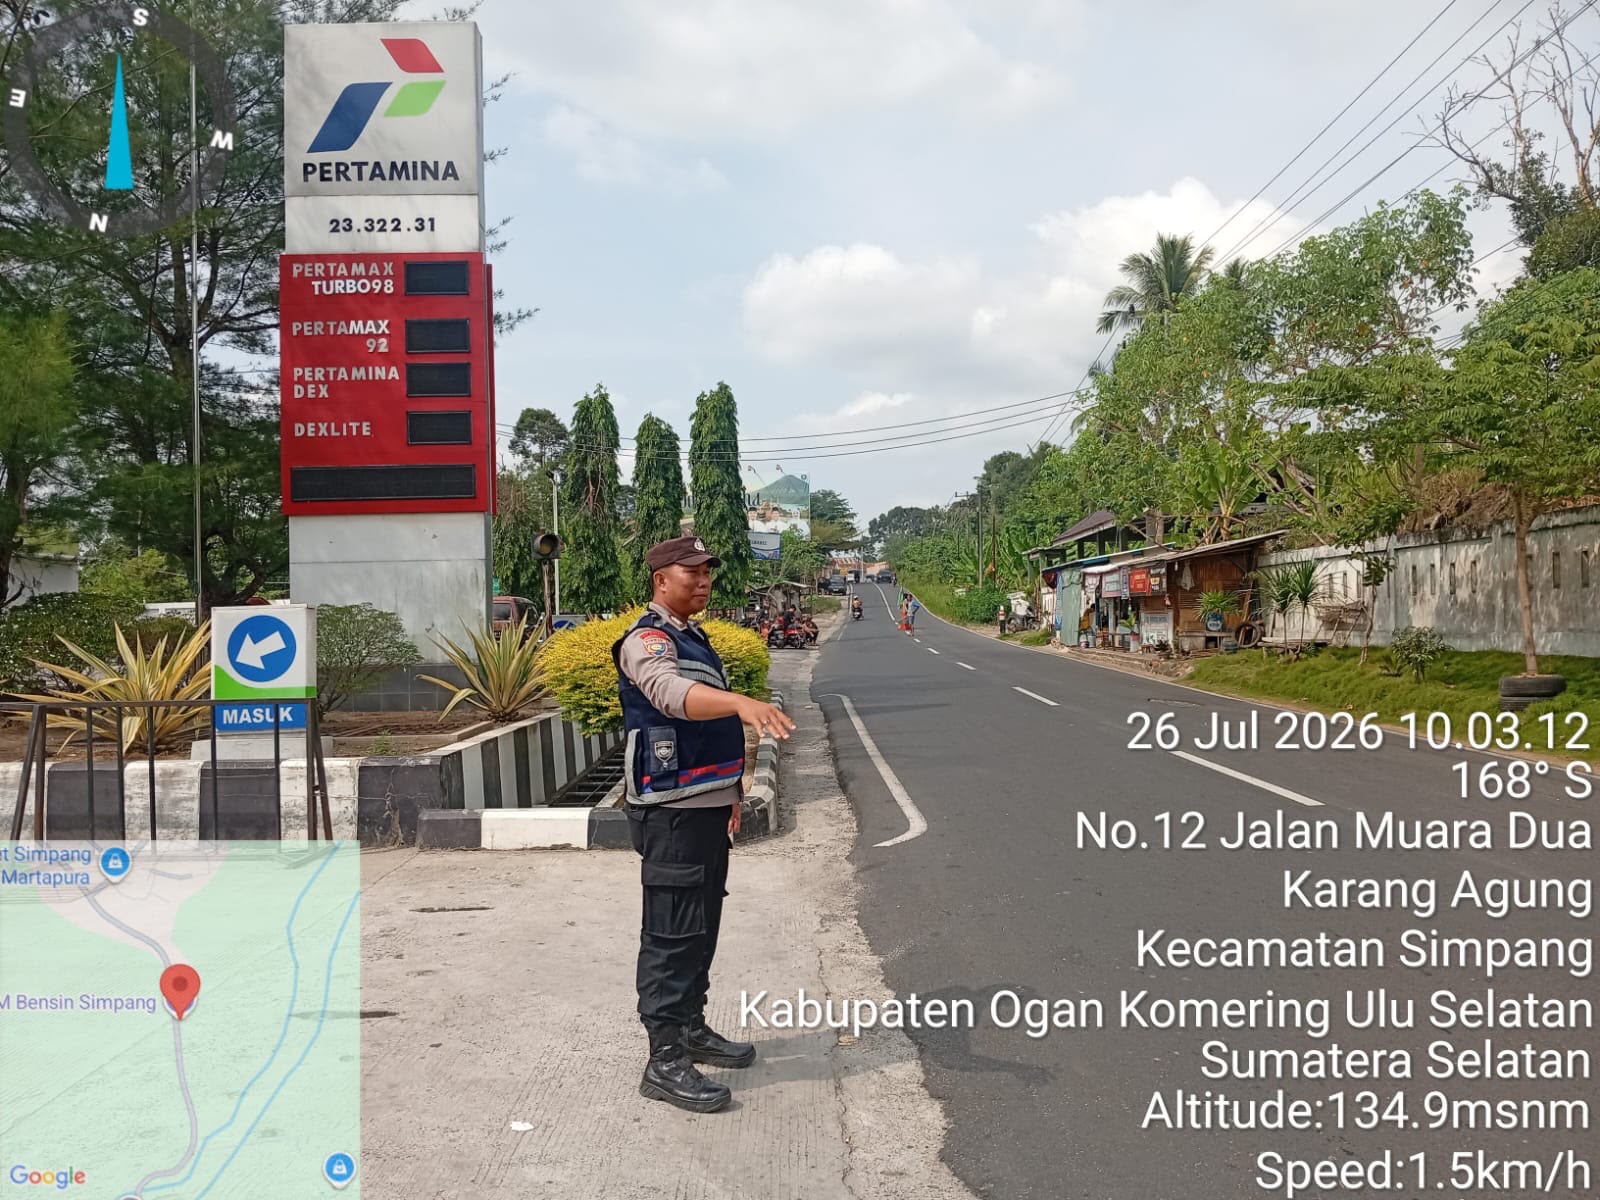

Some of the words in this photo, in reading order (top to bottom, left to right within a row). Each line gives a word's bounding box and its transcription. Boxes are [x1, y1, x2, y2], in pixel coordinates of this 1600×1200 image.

[302, 160, 459, 183] PERTAMINA
[328, 217, 436, 234] 23.322.31
[292, 262, 395, 278] PERTAMAX
[292, 319, 390, 336] PERTAMAX
[366, 338, 389, 353] 92
[293, 366, 400, 381] PERTAMINA
[293, 384, 329, 399] DEX
[294, 422, 371, 437] DEXLITE
[222, 706, 294, 725] MASUK
